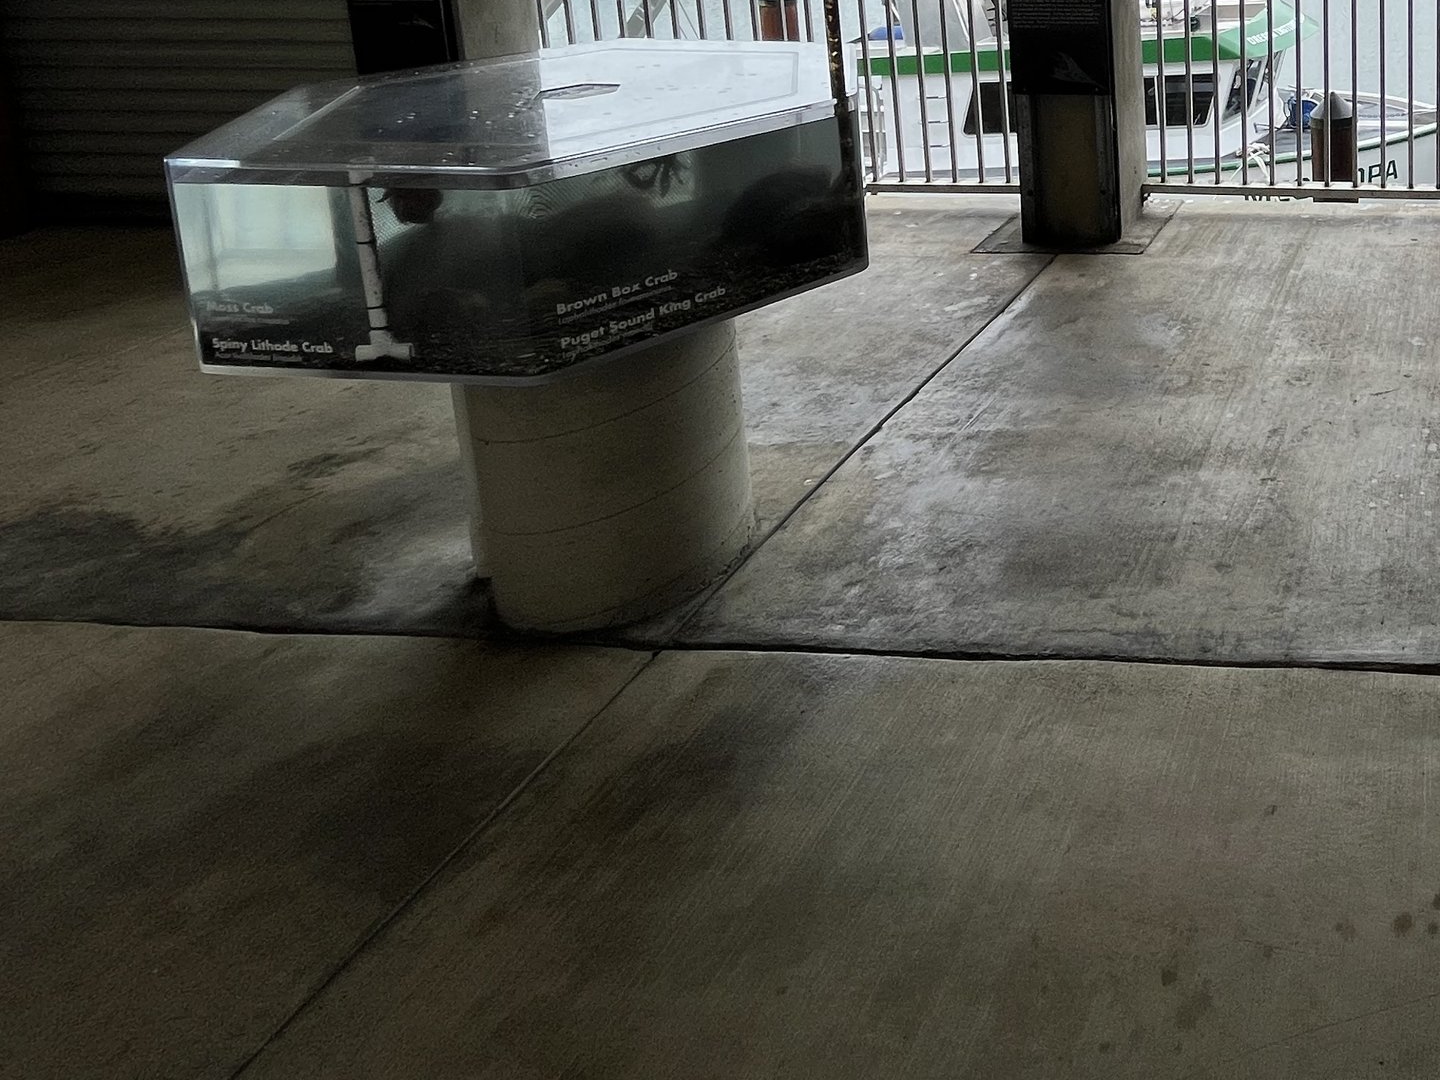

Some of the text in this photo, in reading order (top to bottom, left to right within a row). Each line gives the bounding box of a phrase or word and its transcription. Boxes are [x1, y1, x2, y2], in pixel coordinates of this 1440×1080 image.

[556, 292, 607, 315] Brown
[612, 283, 641, 299] Box
[645, 269, 678, 287] Crab
[243, 302, 274, 314] Crab
[560, 326, 605, 349] Puget
[609, 307, 655, 334] Sound
[659, 299, 691, 315] King
[695, 286, 726, 303] Crab
[212, 338, 333, 353] Spiny Lithode Crab
